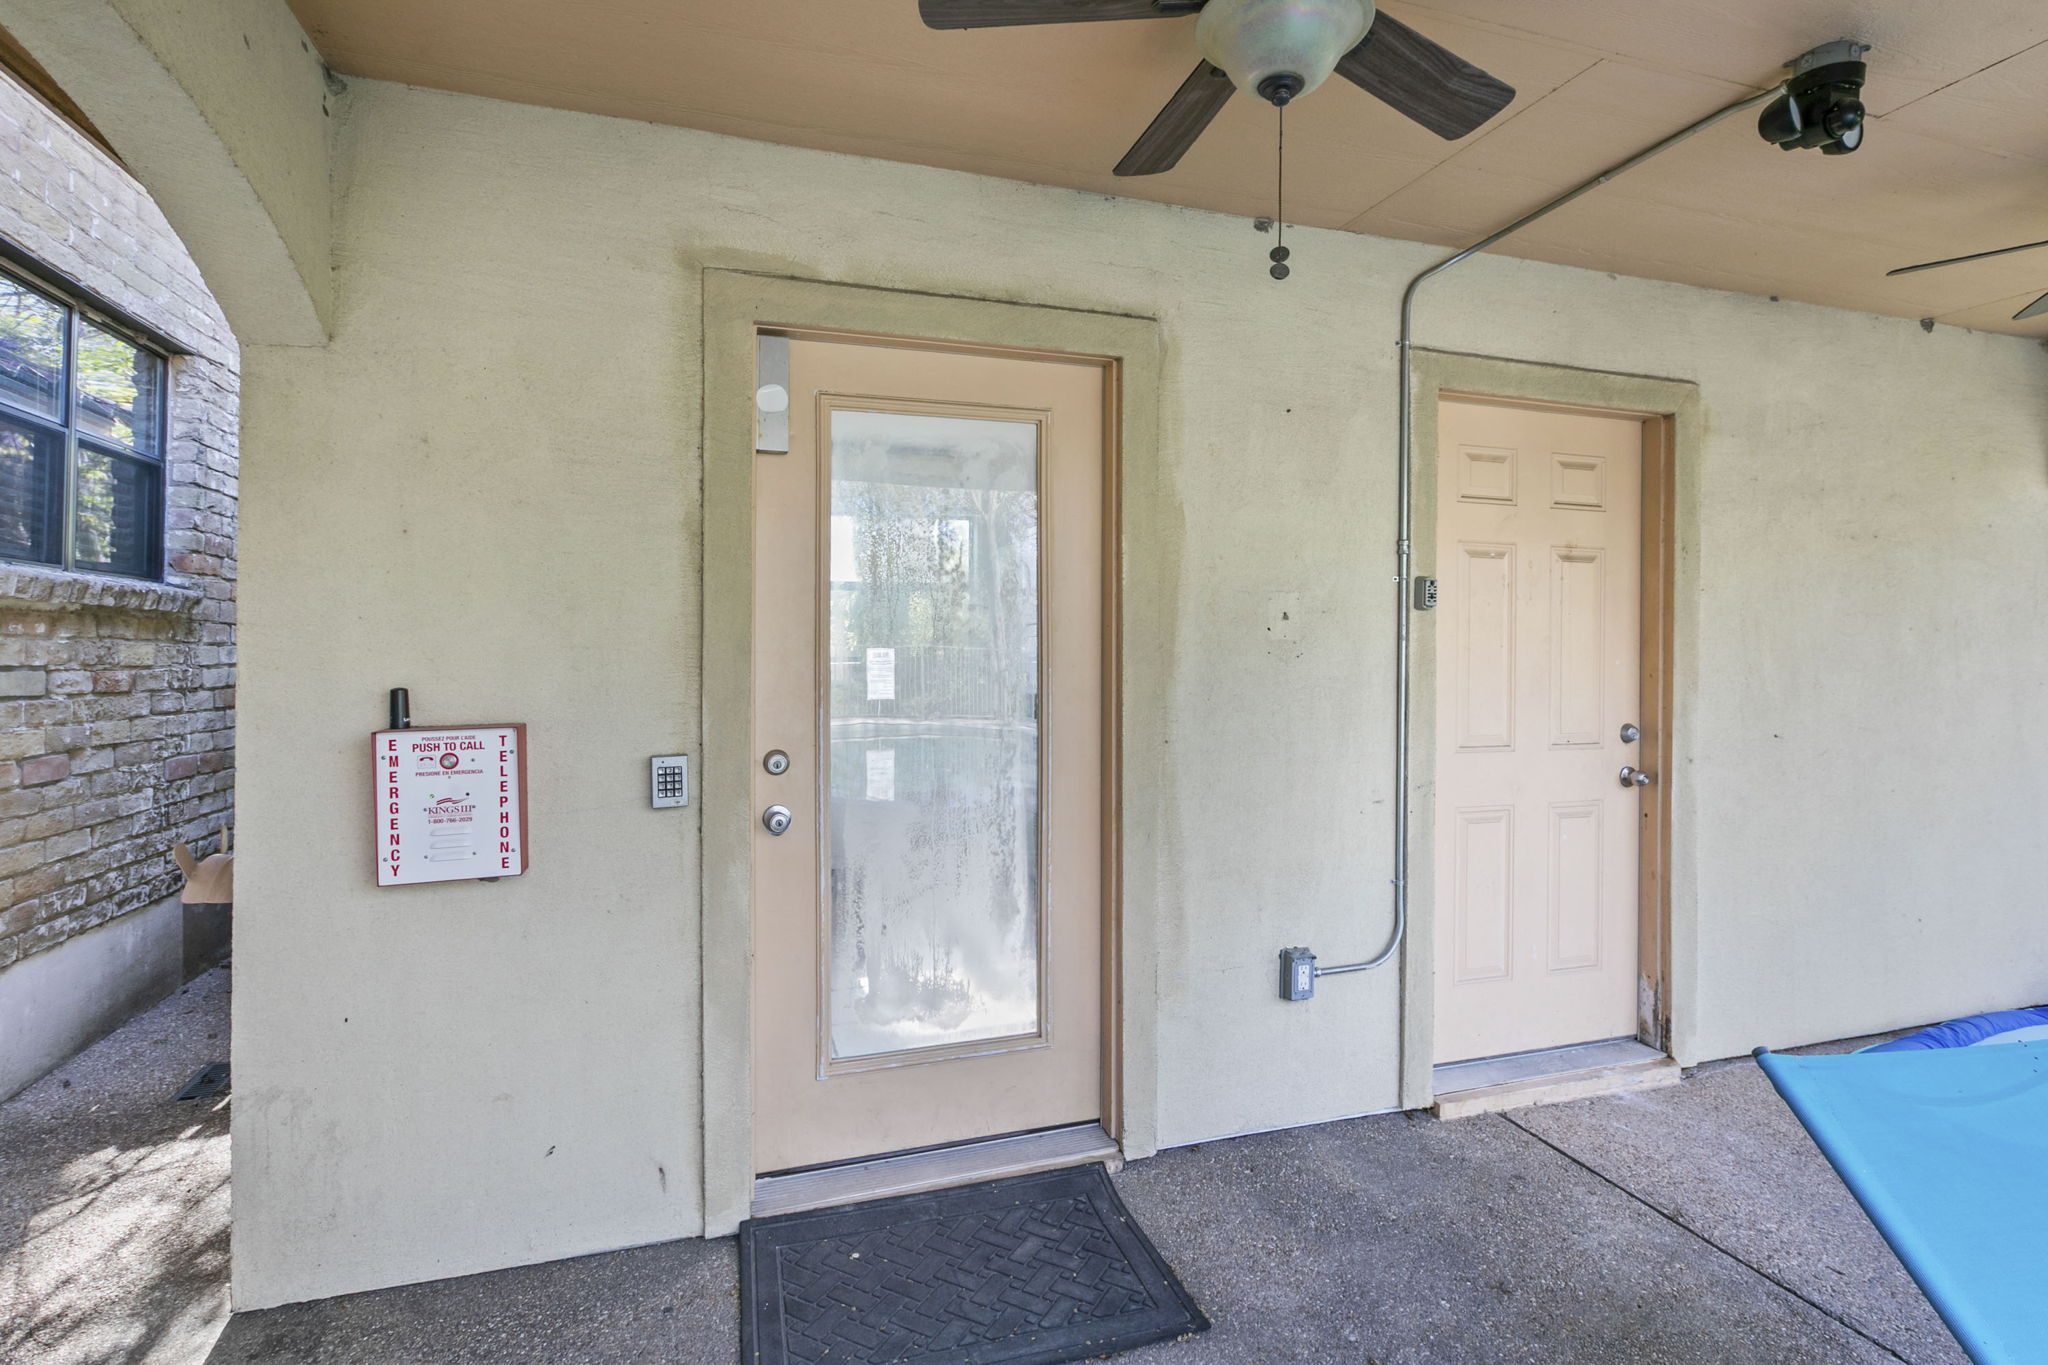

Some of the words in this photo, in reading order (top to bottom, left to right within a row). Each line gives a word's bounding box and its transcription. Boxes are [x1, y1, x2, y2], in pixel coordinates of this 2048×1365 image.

[388, 739, 400, 876] EMERGENCY
[412, 743, 440, 752] PUSH
[443, 742, 456, 751] TO
[460, 741, 485, 751] CALL
[499, 735, 510, 869] TELEPHONE
